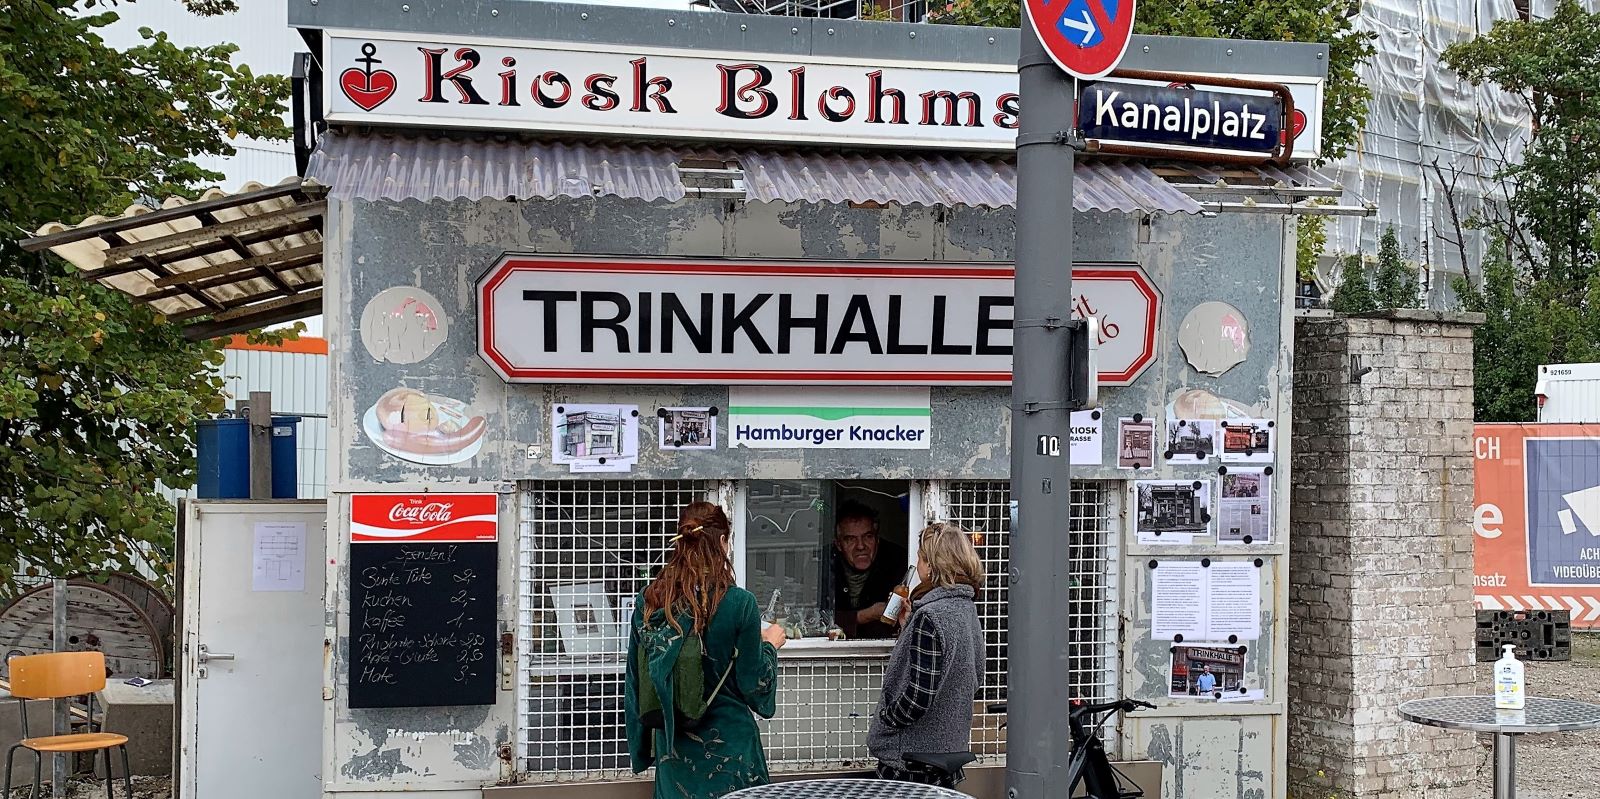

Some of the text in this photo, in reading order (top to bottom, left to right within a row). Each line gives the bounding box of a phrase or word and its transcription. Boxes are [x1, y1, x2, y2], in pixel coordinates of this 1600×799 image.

[417, 46, 1019, 129] Kiosk Blohms
[1095, 89, 1266, 140] Kanalplatz
[523, 289, 1015, 356] TRINKHALLE
[736, 424, 925, 444] Hamburger Knacker
[1040, 435, 1061, 456] 10
[1475, 437, 1500, 459] CH
[388, 502, 454, 522] Coca-Cola
[1192, 649, 1233, 661] TRINKHALLE
